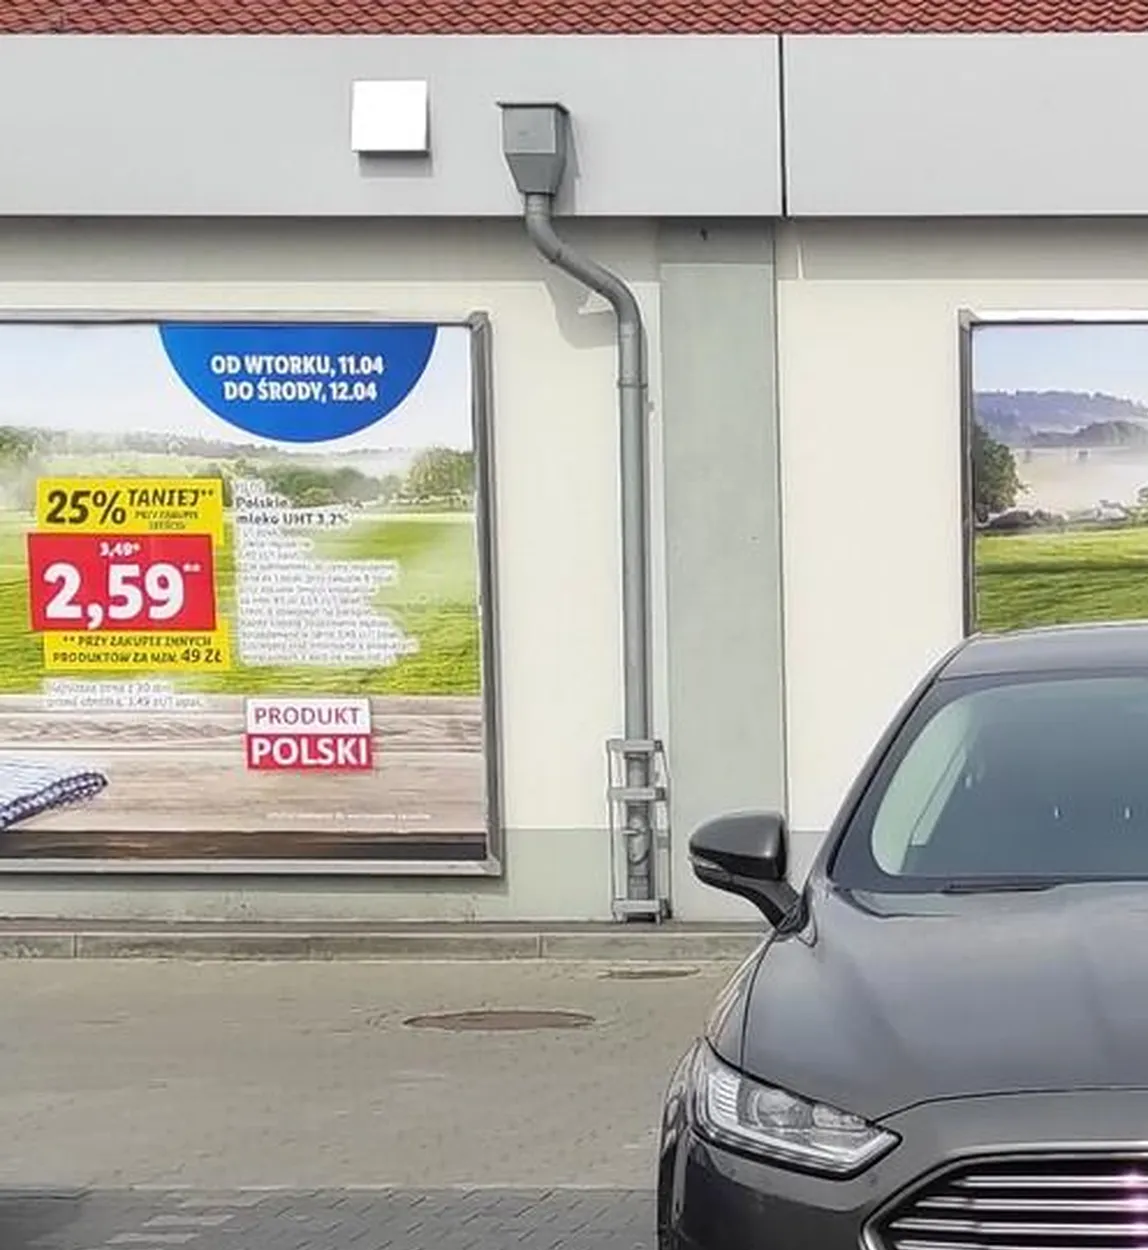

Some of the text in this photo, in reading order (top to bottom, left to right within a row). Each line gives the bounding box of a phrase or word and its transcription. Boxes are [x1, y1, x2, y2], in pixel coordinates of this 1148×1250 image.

[210, 355, 384, 378] OD WTORKU, 11.04
[223, 377, 378, 403] DO ŚRODY, 12.04
[45, 489, 127, 525] 25%
[235, 497, 288, 510] Polskie
[235, 512, 279, 525] mleko
[283, 513, 312, 525] UHT
[78, 635, 107, 647] PRZY
[164, 635, 212, 647] INNYCH
[132, 651, 149, 663] ZA
[180, 648, 201, 663] 49
[254, 706, 361, 725] PRODUKT
[251, 736, 368, 766] POLSKI
